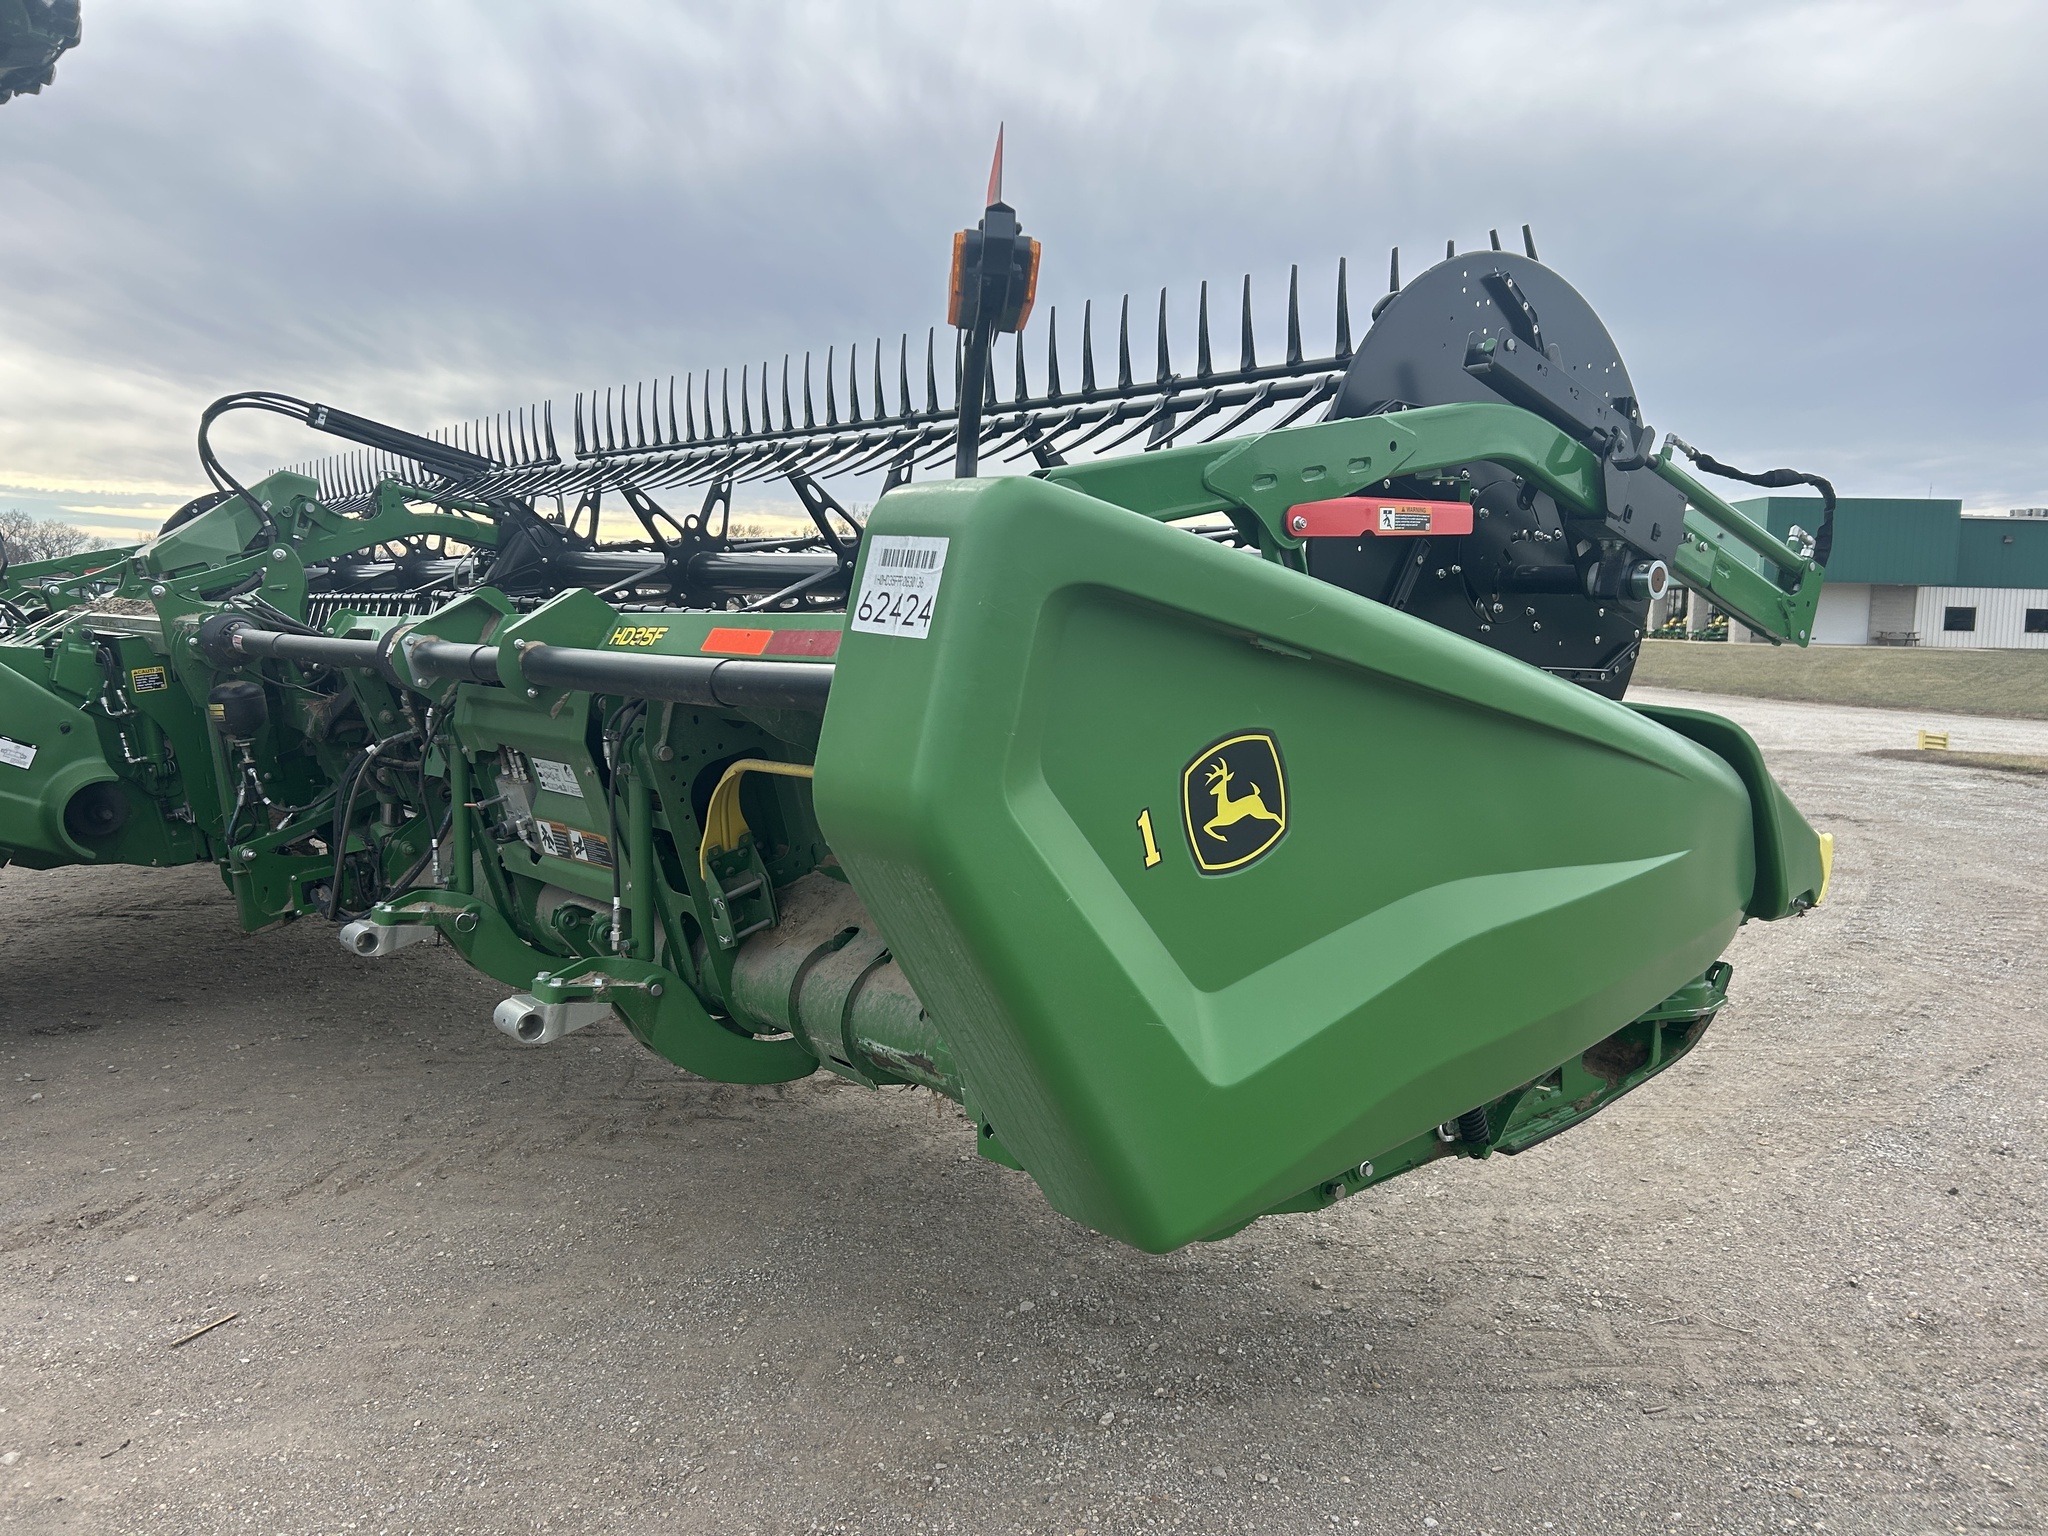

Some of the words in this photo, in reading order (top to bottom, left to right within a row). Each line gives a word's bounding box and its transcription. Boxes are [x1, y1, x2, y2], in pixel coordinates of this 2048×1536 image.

[1542, 366, 1549, 377] 3
[1573, 389, 1580, 401] 2
[858, 590, 933, 628] 62424
[608, 626, 670, 647] HD35F
[1136, 806, 1163, 871] 1
